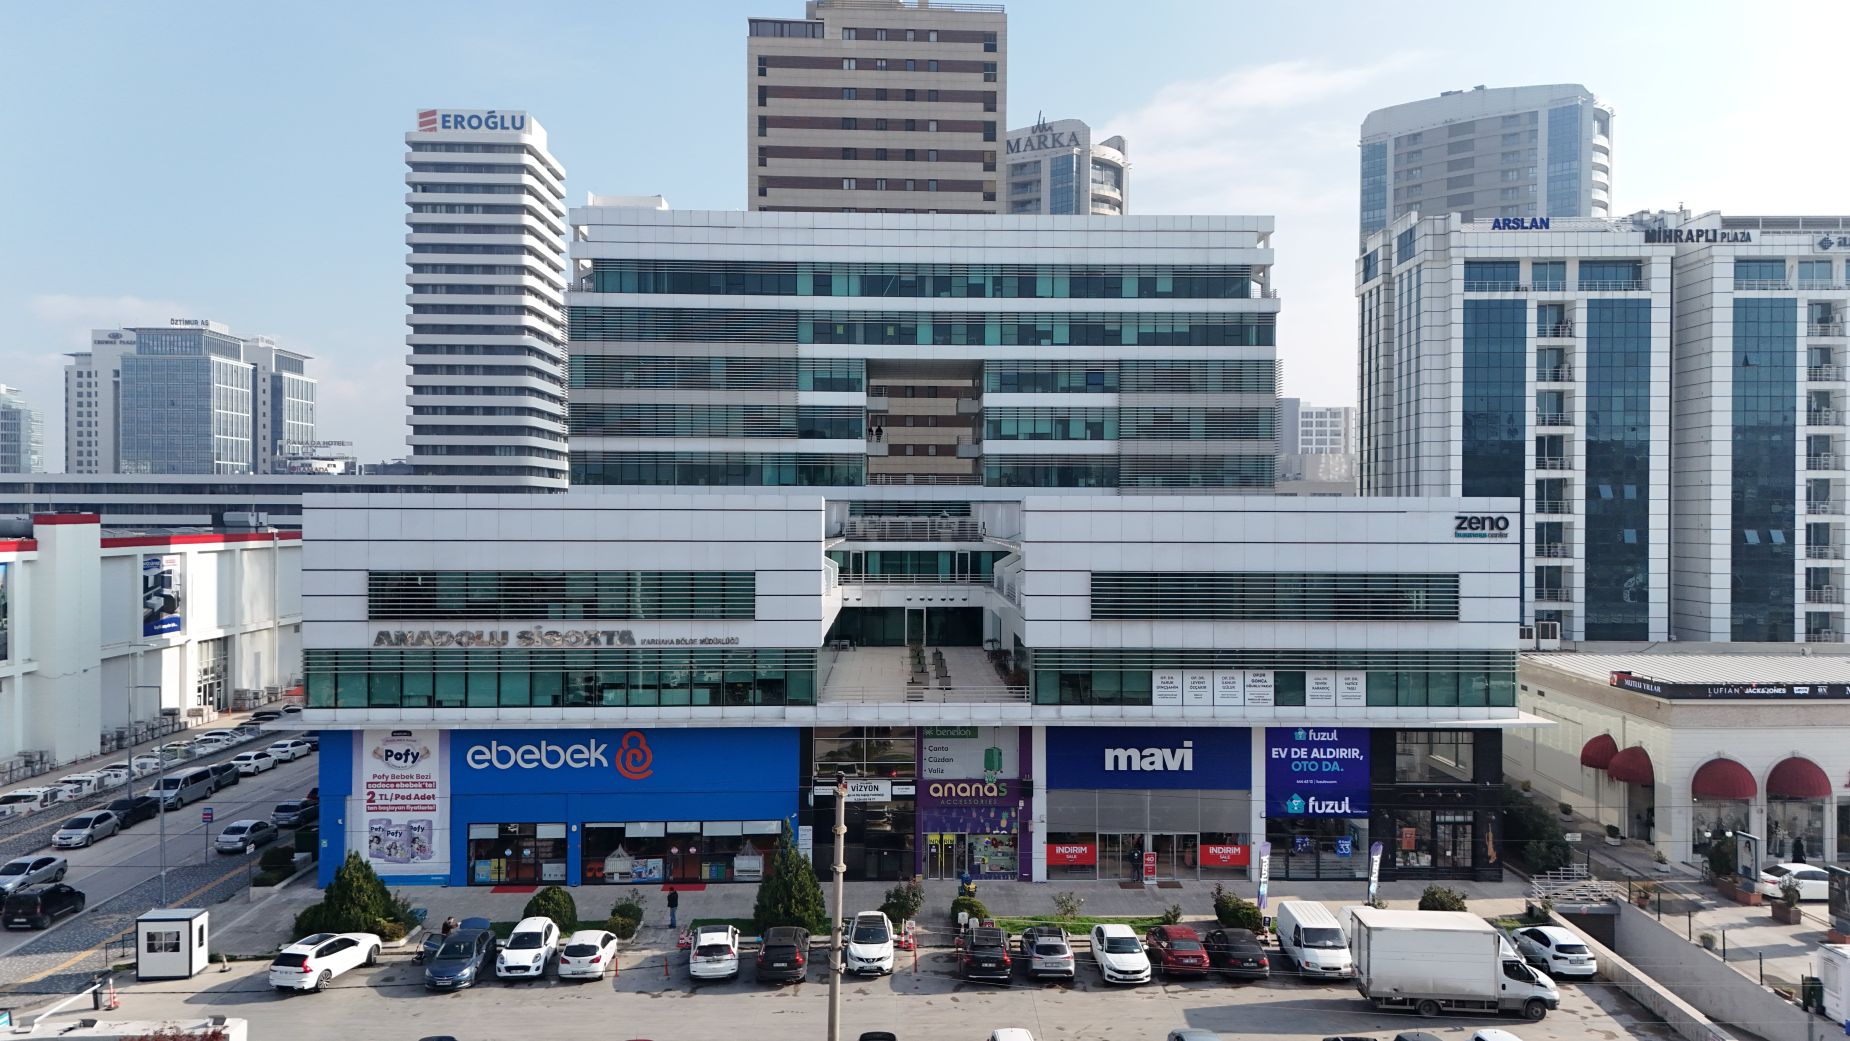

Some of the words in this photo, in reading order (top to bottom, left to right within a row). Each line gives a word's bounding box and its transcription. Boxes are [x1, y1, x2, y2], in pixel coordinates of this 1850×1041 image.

[441, 110, 525, 131] EROĞLU
[1006, 131, 1080, 154] MARKA
[1491, 217, 1550, 231] ARSLAN
[1644, 227, 1718, 244] MİHRAPLI
[1720, 231, 1752, 243] PLAZA
[170, 317, 199, 326] ÖZTİMUR
[1454, 515, 1510, 531] zeno
[373, 630, 510, 648] ANADOLU
[516, 624, 637, 648] SİGORTA
[1708, 687, 1740, 695] LUFIAN
[1744, 686, 1787, 694] JACK&JONES
[1308, 729, 1339, 741] fuzul
[384, 748, 420, 764] Pofy
[466, 738, 609, 769] ebebek
[927, 756, 955, 764] Cüzdan
[1104, 740, 1193, 771] mavi
[1271, 748, 1288, 759] EV
[1291, 748, 1308, 759] DE
[1310, 748, 1364, 761] ALDIRIR,
[1291, 761, 1319, 772] OTO
[1321, 761, 1345, 772] DA.
[391, 773, 415, 781] Bebek
[416, 773, 432, 781] Bezi
[850, 783, 880, 792] VİZYON
[929, 782, 1008, 798] ananas
[366, 791, 376, 804] 2
[413, 793, 437, 801] Adet
[1308, 796, 1351, 814] fuzul
[387, 830, 403, 838] Pofy
[1056, 846, 1088, 854] İNDİRİM
[1209, 846, 1241, 854] İNDİRİM
[1337, 843, 1352, 854] 33
